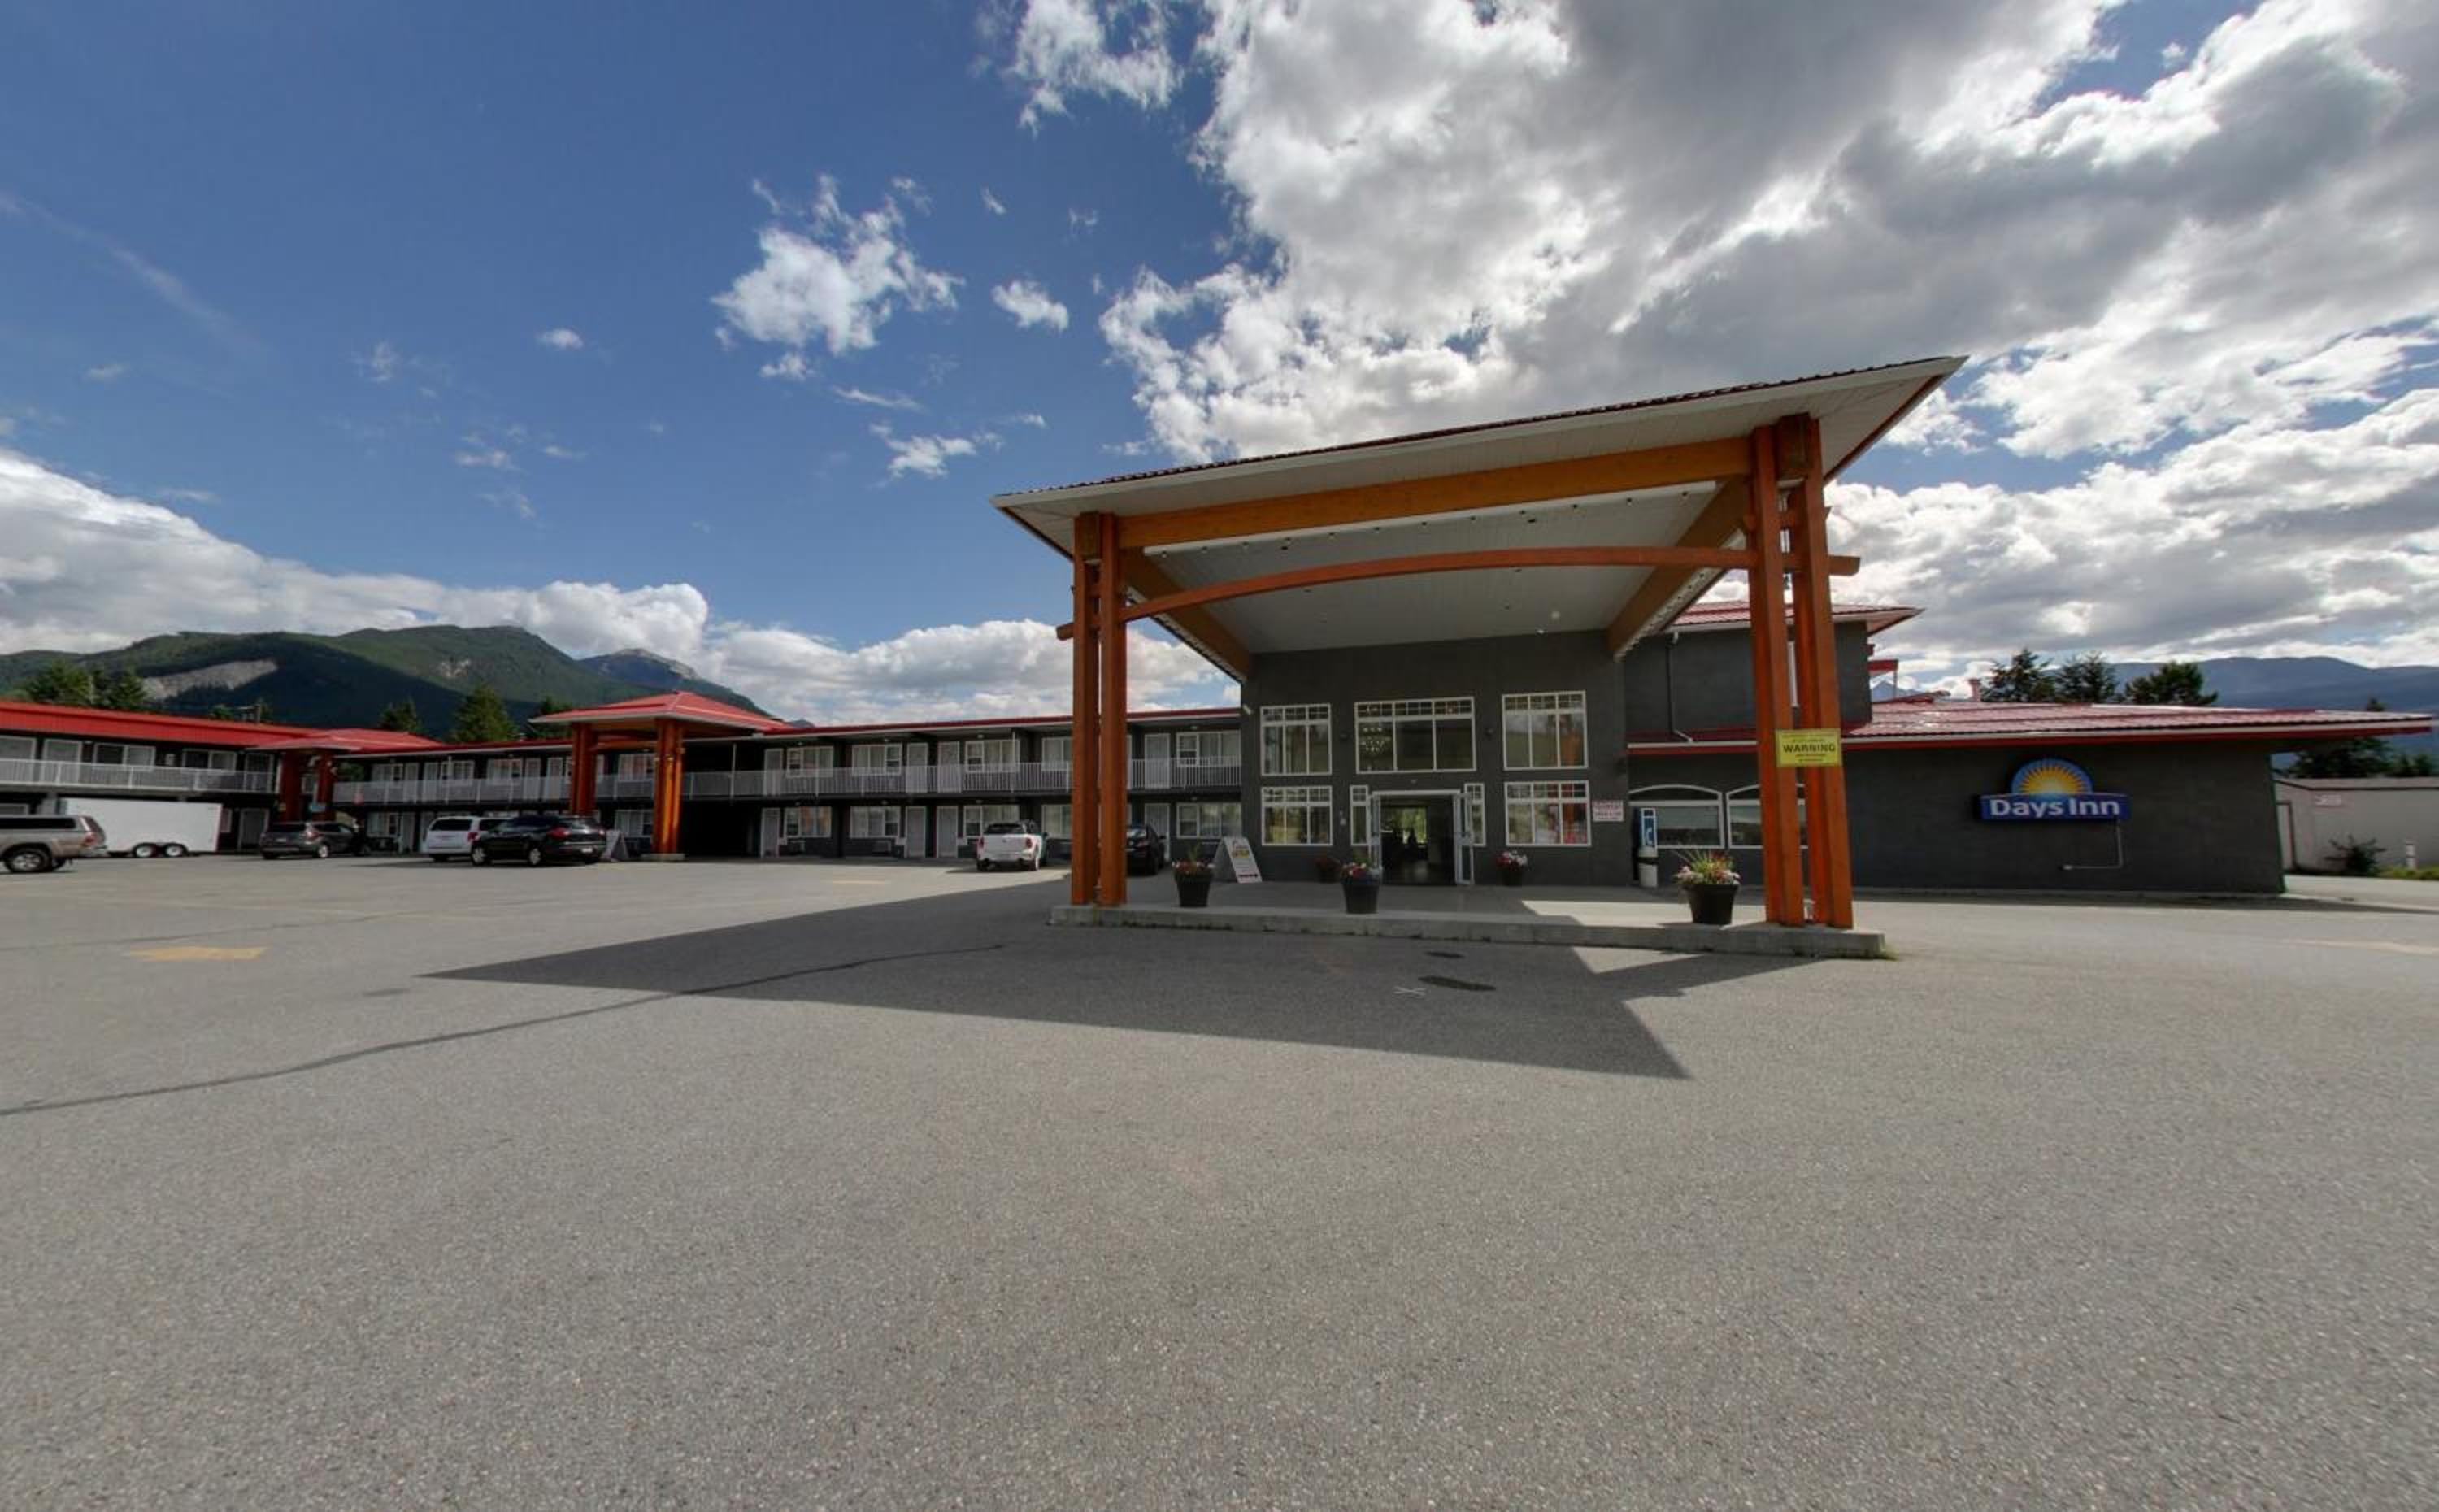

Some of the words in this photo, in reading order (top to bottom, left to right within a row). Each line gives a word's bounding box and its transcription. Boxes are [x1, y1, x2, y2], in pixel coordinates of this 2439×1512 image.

[1782, 743, 1835, 753] WARNING
[1989, 798, 2063, 818] Days
[2068, 797, 2121, 815] Inn
